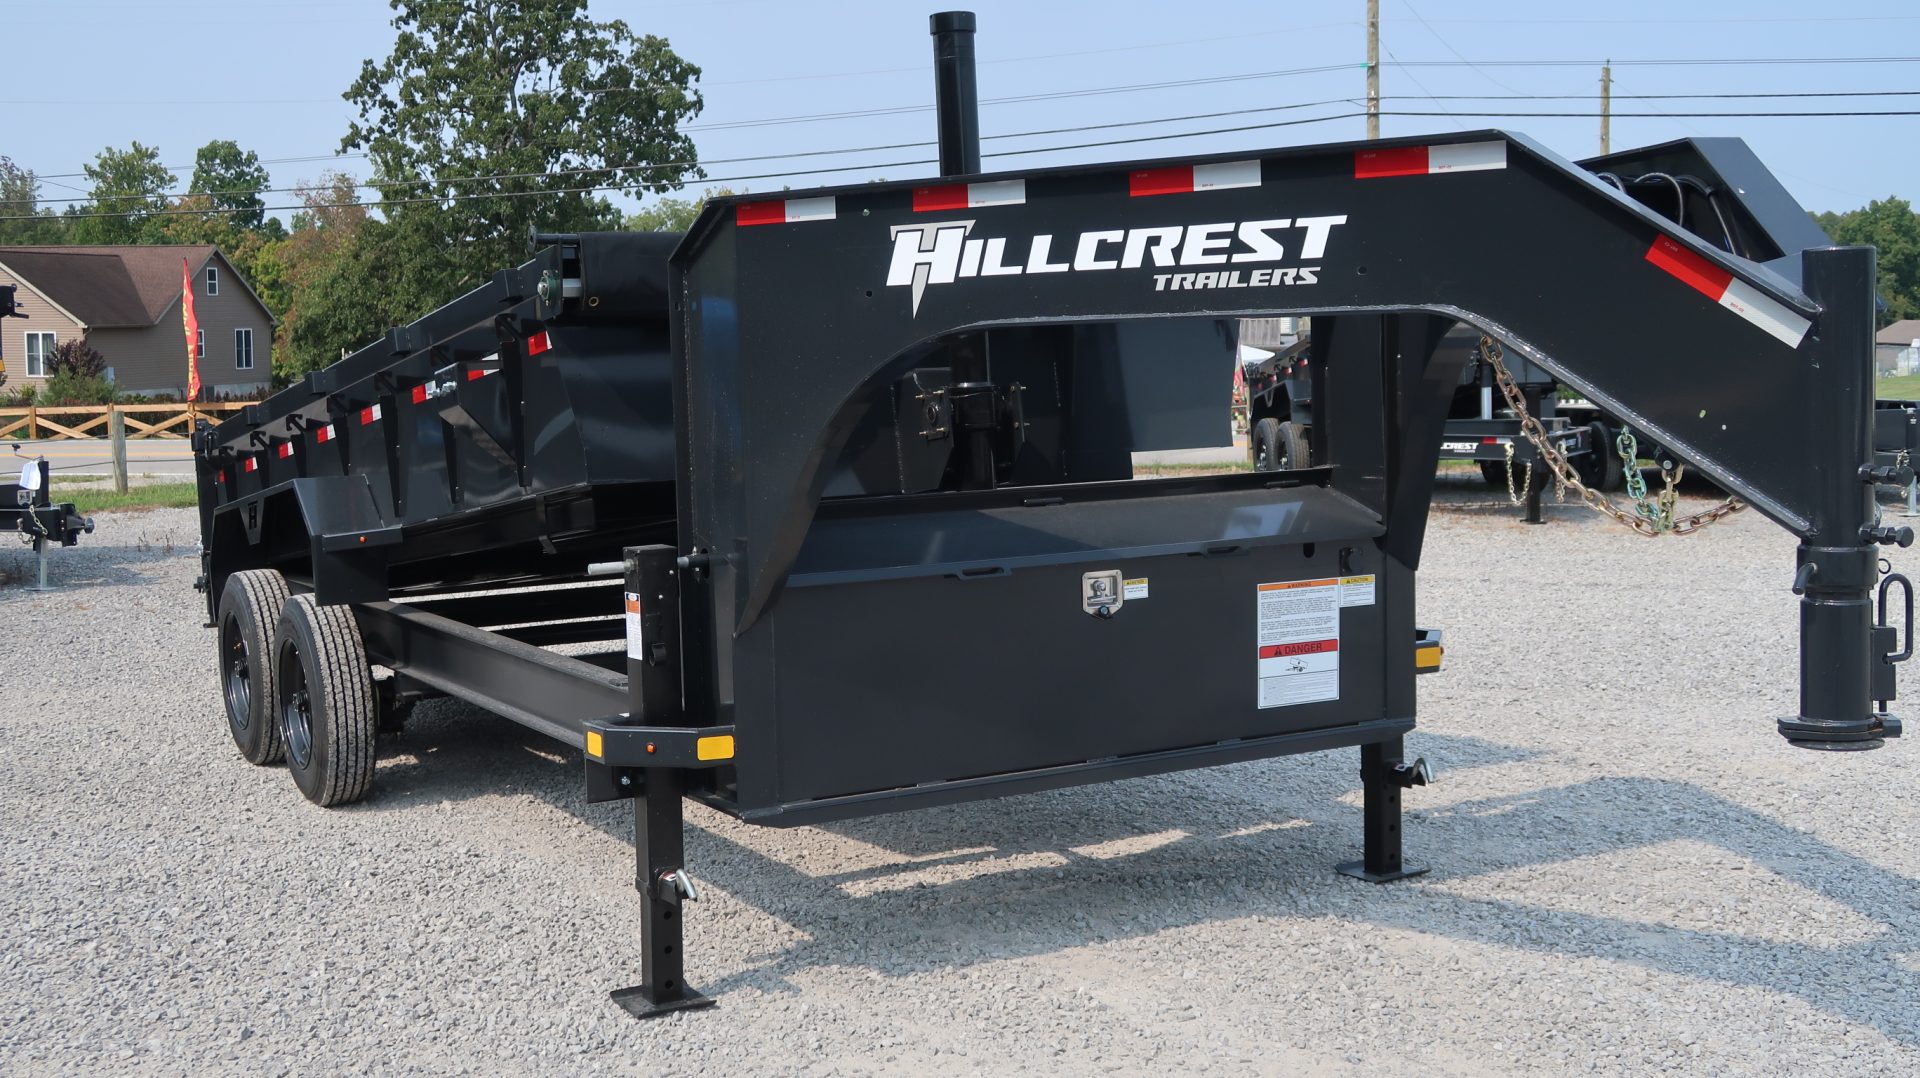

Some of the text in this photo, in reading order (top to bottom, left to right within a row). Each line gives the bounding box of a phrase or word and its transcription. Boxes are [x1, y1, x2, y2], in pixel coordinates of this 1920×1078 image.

[886, 215, 1347, 319] HILLCREST
[1153, 267, 1321, 291] TRAILERS
[1284, 643, 1322, 655] DANGER
